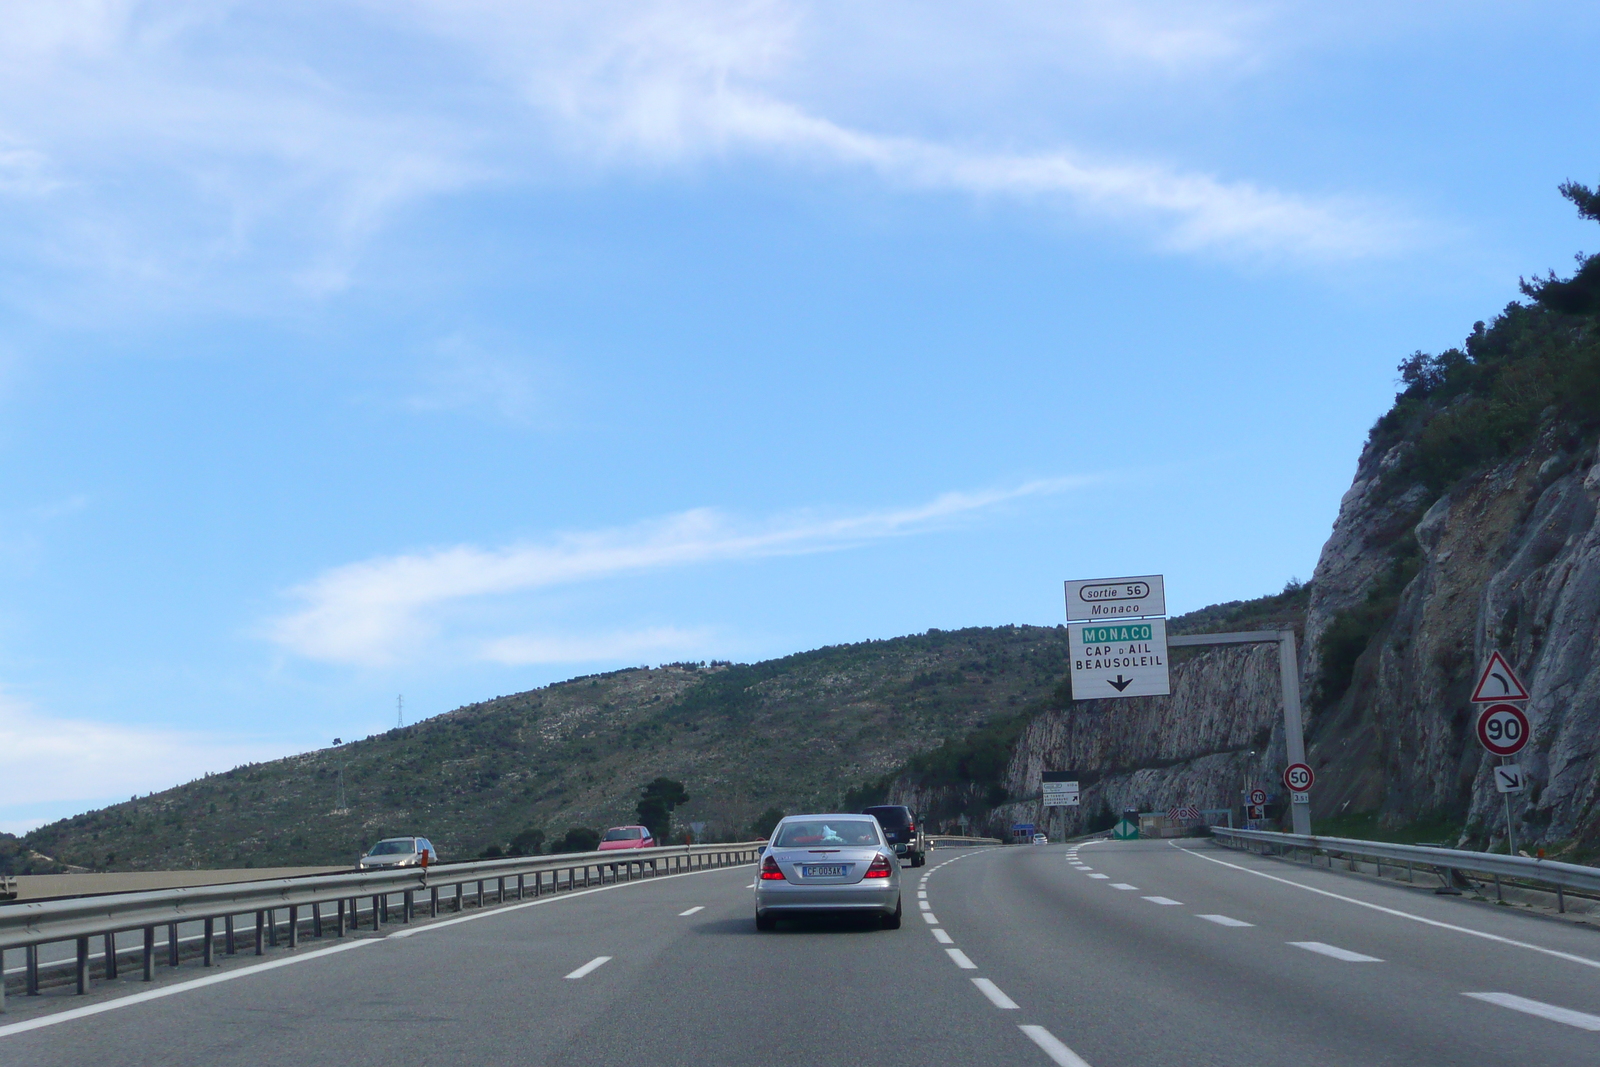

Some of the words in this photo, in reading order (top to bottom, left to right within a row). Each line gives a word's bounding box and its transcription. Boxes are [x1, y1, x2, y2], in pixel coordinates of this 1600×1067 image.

[1087, 587, 1117, 598] sortie
[1126, 585, 1141, 596] 56
[1091, 604, 1139, 615] Monaco
[1084, 626, 1150, 642] MONACO
[1085, 646, 1111, 657] CAP
[1076, 656, 1163, 670] BEAUSOLEIL
[1487, 718, 1520, 740] 90
[1291, 771, 1308, 784] 50
[1254, 793, 1263, 801] 70
[808, 867, 816, 875] CF
